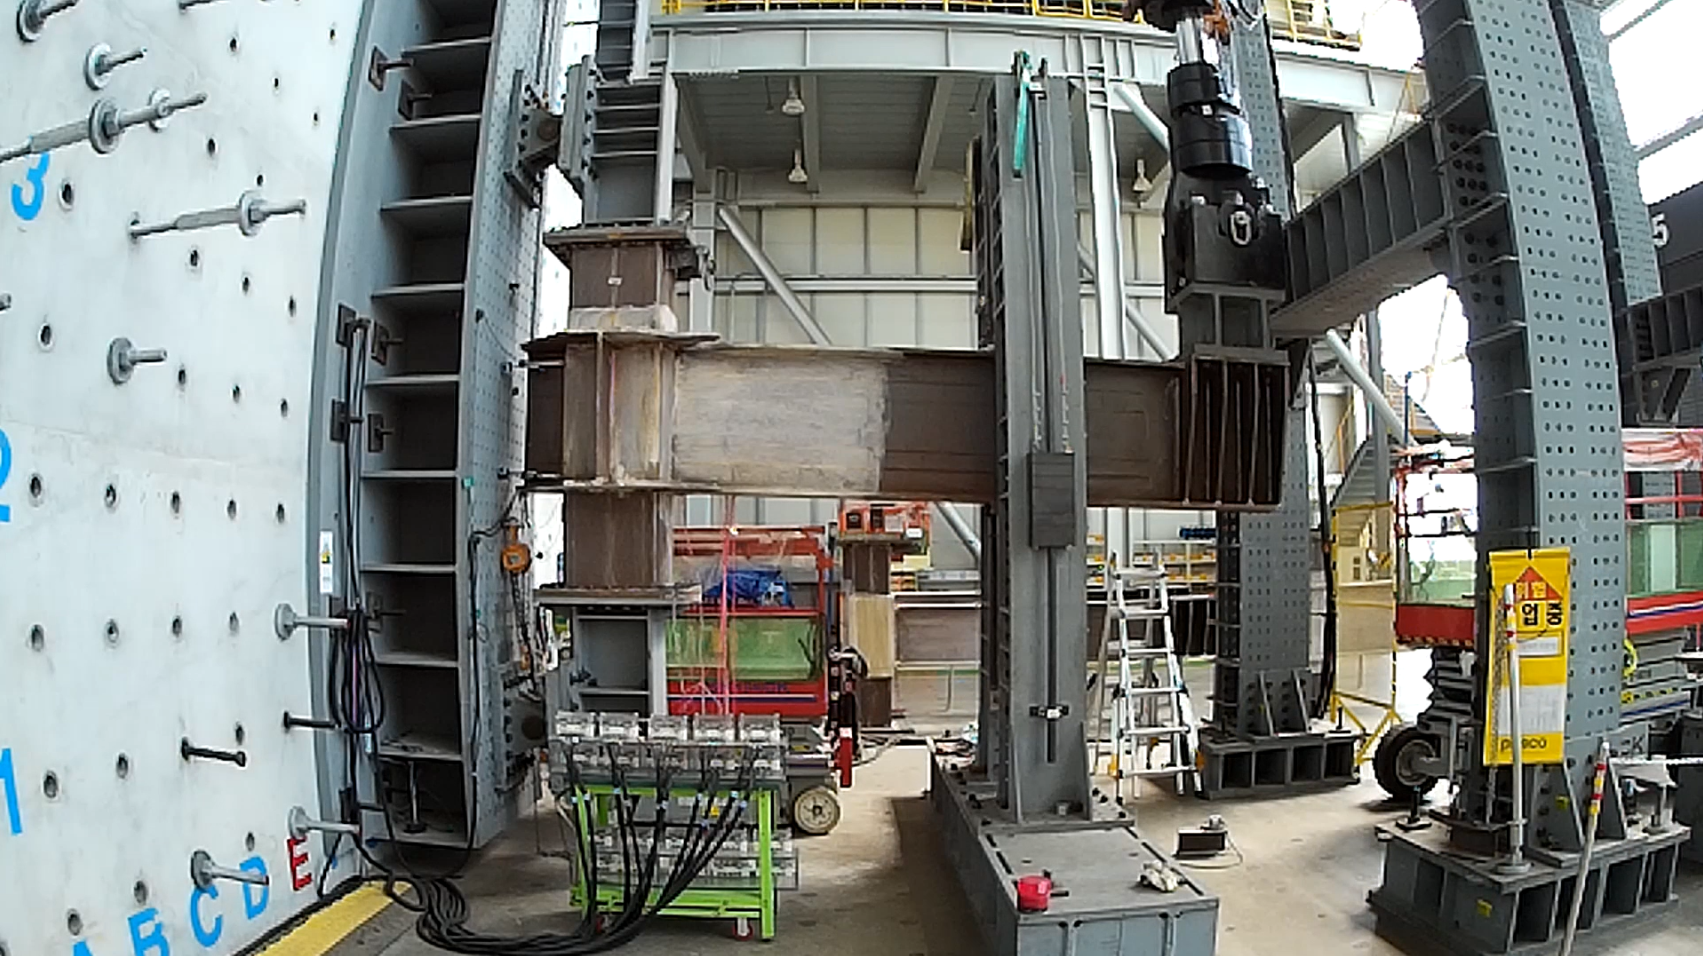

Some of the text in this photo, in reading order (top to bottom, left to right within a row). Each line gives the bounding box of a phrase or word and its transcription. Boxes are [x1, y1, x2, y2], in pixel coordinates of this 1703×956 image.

[12, 150, 50, 221] 3
[190, 884, 223, 948] C
[239, 855, 269, 920] D
[287, 836, 312, 891] E
